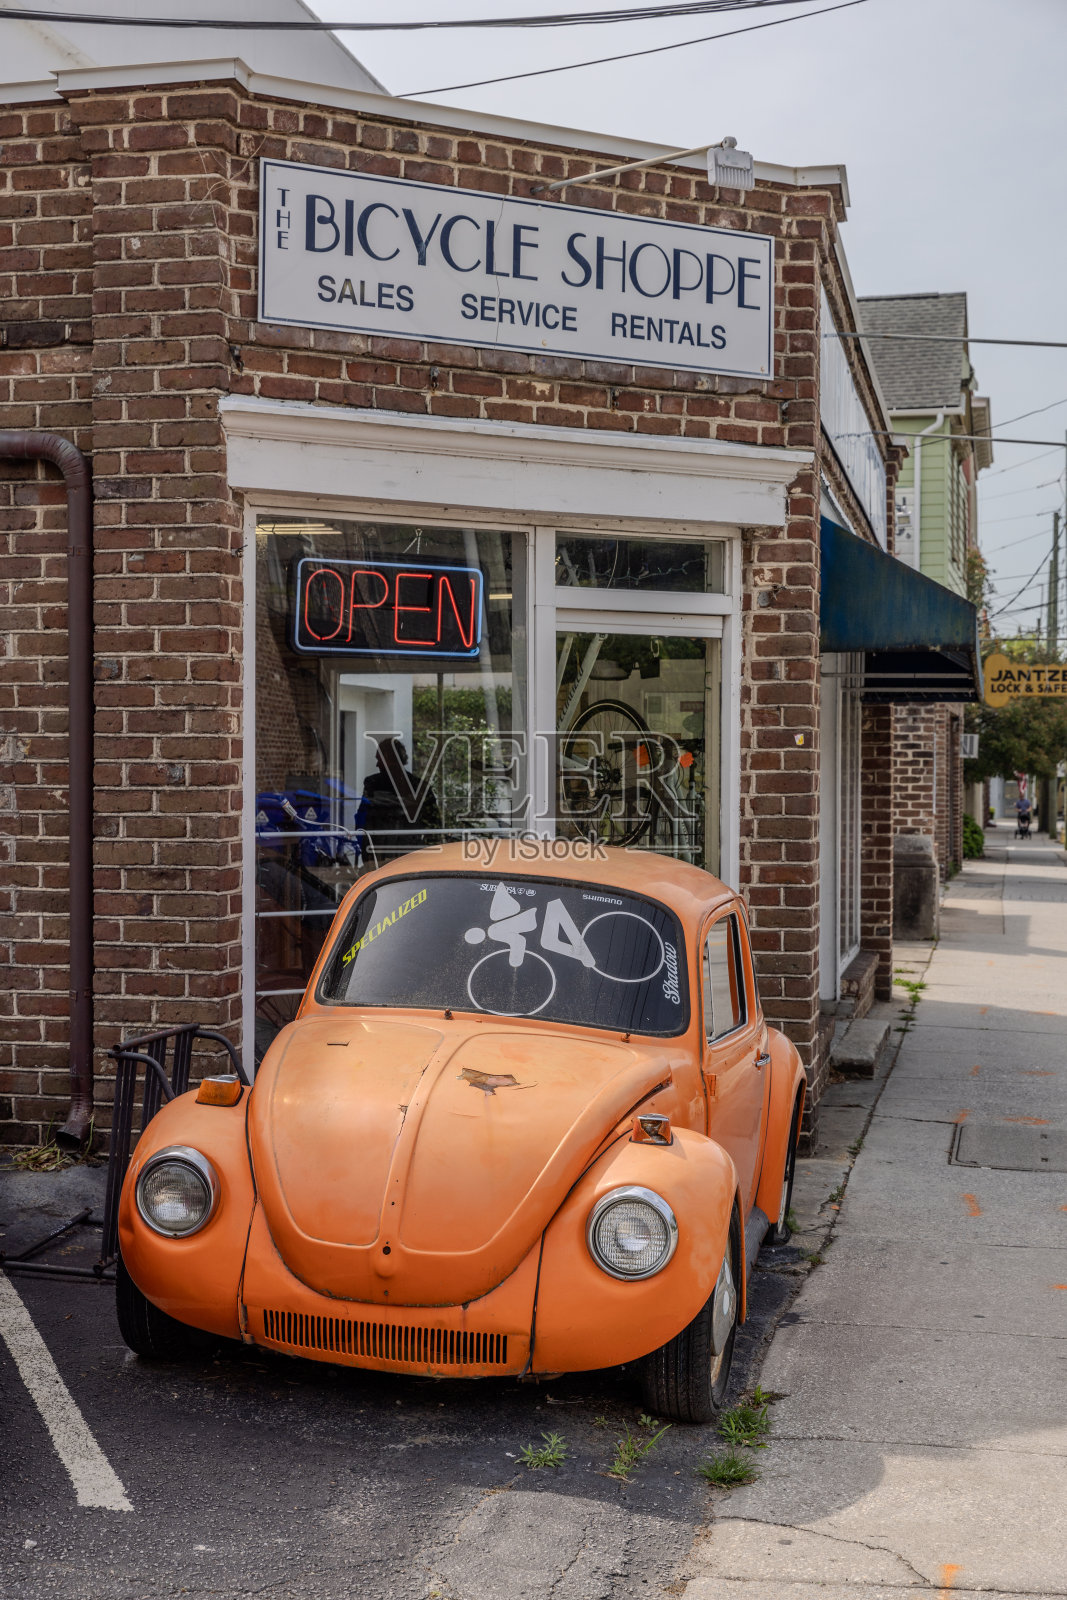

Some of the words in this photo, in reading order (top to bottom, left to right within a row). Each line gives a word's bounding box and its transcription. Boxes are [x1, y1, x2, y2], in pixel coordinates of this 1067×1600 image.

[276, 187, 291, 250] THE
[304, 193, 540, 282] BICYCLE
[560, 231, 762, 311] SHOPPE
[316, 274, 415, 312] SALES
[460, 293, 578, 332] SERVICE
[610, 312, 727, 350] RENTALS
[304, 568, 476, 649] OPEN
[991, 683, 1021, 693] LOCK
[1025, 683, 1034, 693] &
[1038, 683, 1067, 693] SAFE
[480, 883, 517, 895] SUBSA
[582, 893, 623, 906] SHIMANO
[342, 888, 428, 969] SPECIALIZED
[662, 941, 681, 1005] Shadow
